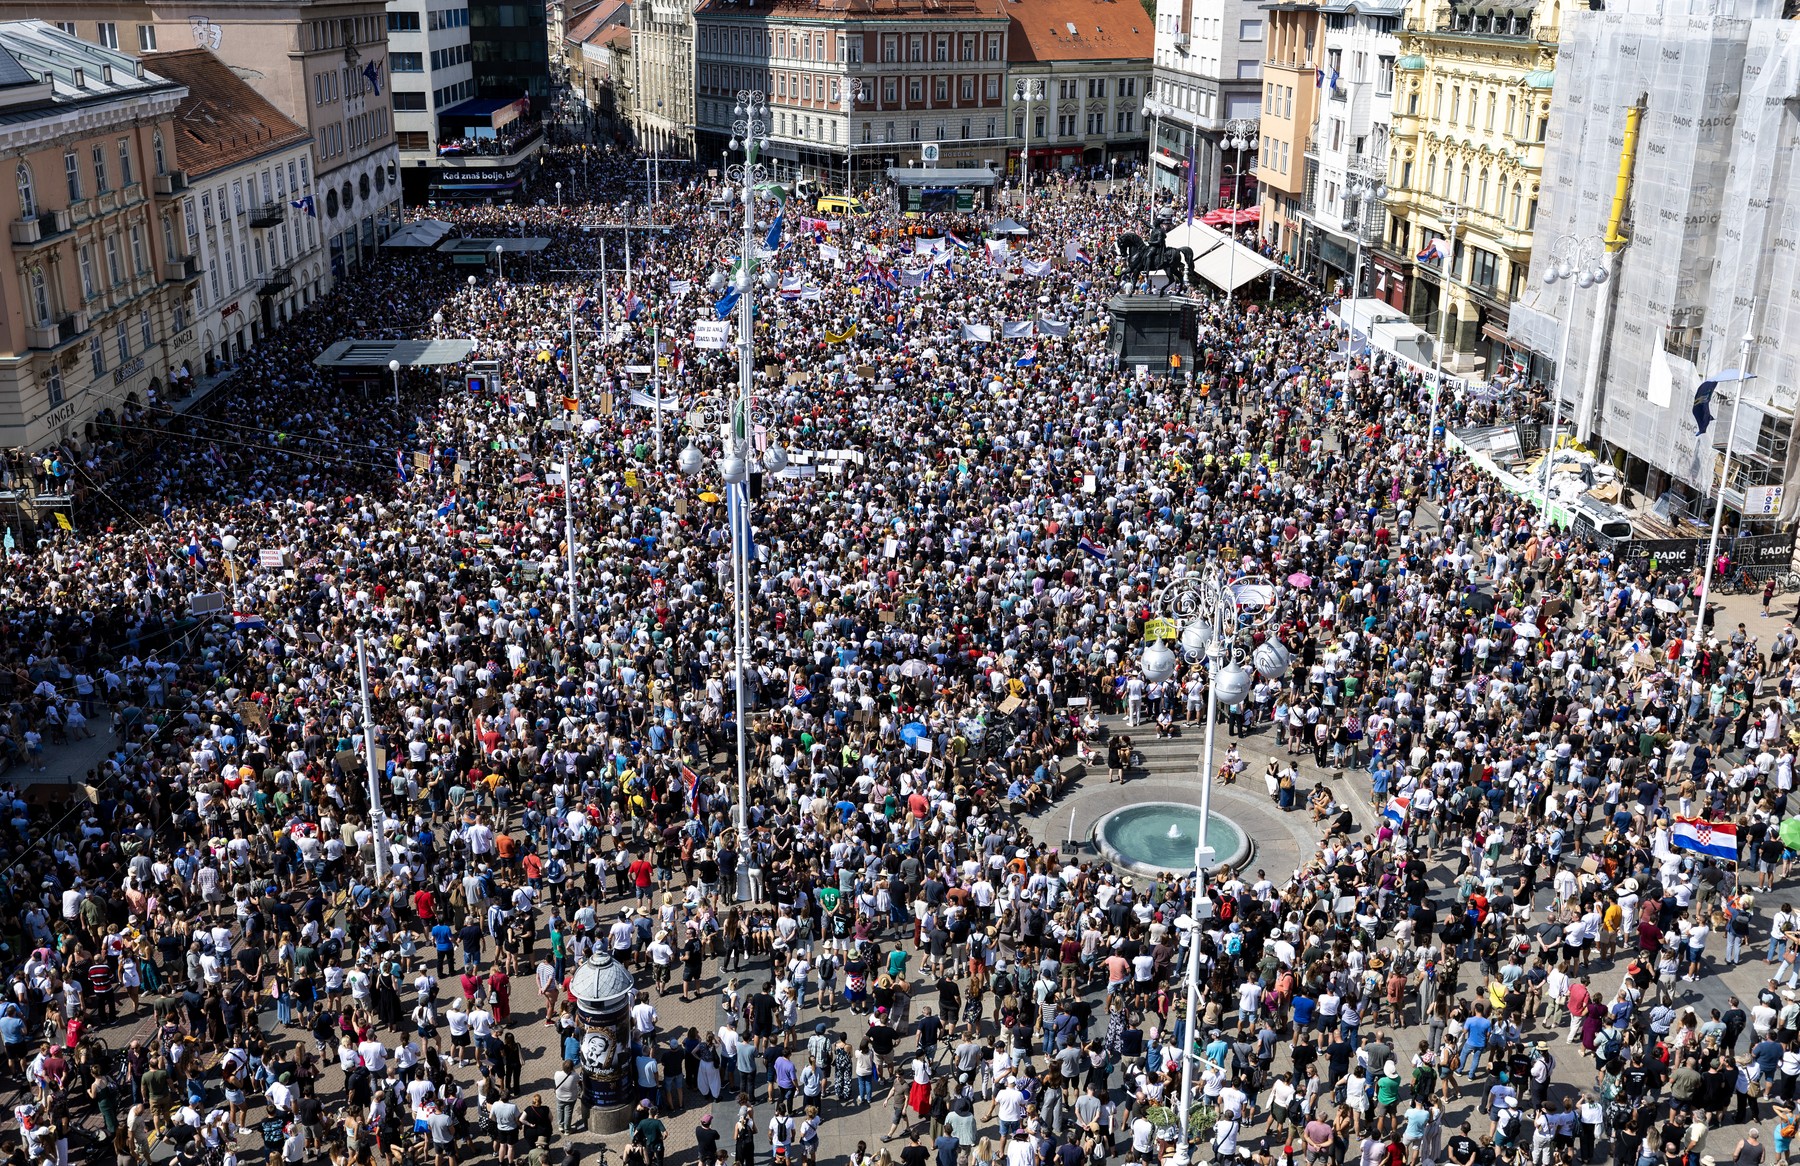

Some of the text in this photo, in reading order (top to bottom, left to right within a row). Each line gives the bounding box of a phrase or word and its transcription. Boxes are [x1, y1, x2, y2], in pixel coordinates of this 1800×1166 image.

[1662, 47, 1680, 60] RADIĆ
[1673, 115, 1692, 128] RADIĆ
[1697, 114, 1732, 127] RADIĆ
[443, 172, 459, 180] Kad
[461, 171, 480, 180] znaš
[482, 171, 505, 181] bolje,
[1660, 209, 1679, 222] RADIĆ
[173, 330, 193, 350] SINGER
[1757, 335, 1779, 349] RADIĆ
[1777, 386, 1797, 399] RADIĆ
[46, 402, 76, 430] SINGER
[1653, 549, 1687, 560] RADIĆ
[1760, 544, 1792, 556] RADIĆ
[824, 893, 835, 902] 45
